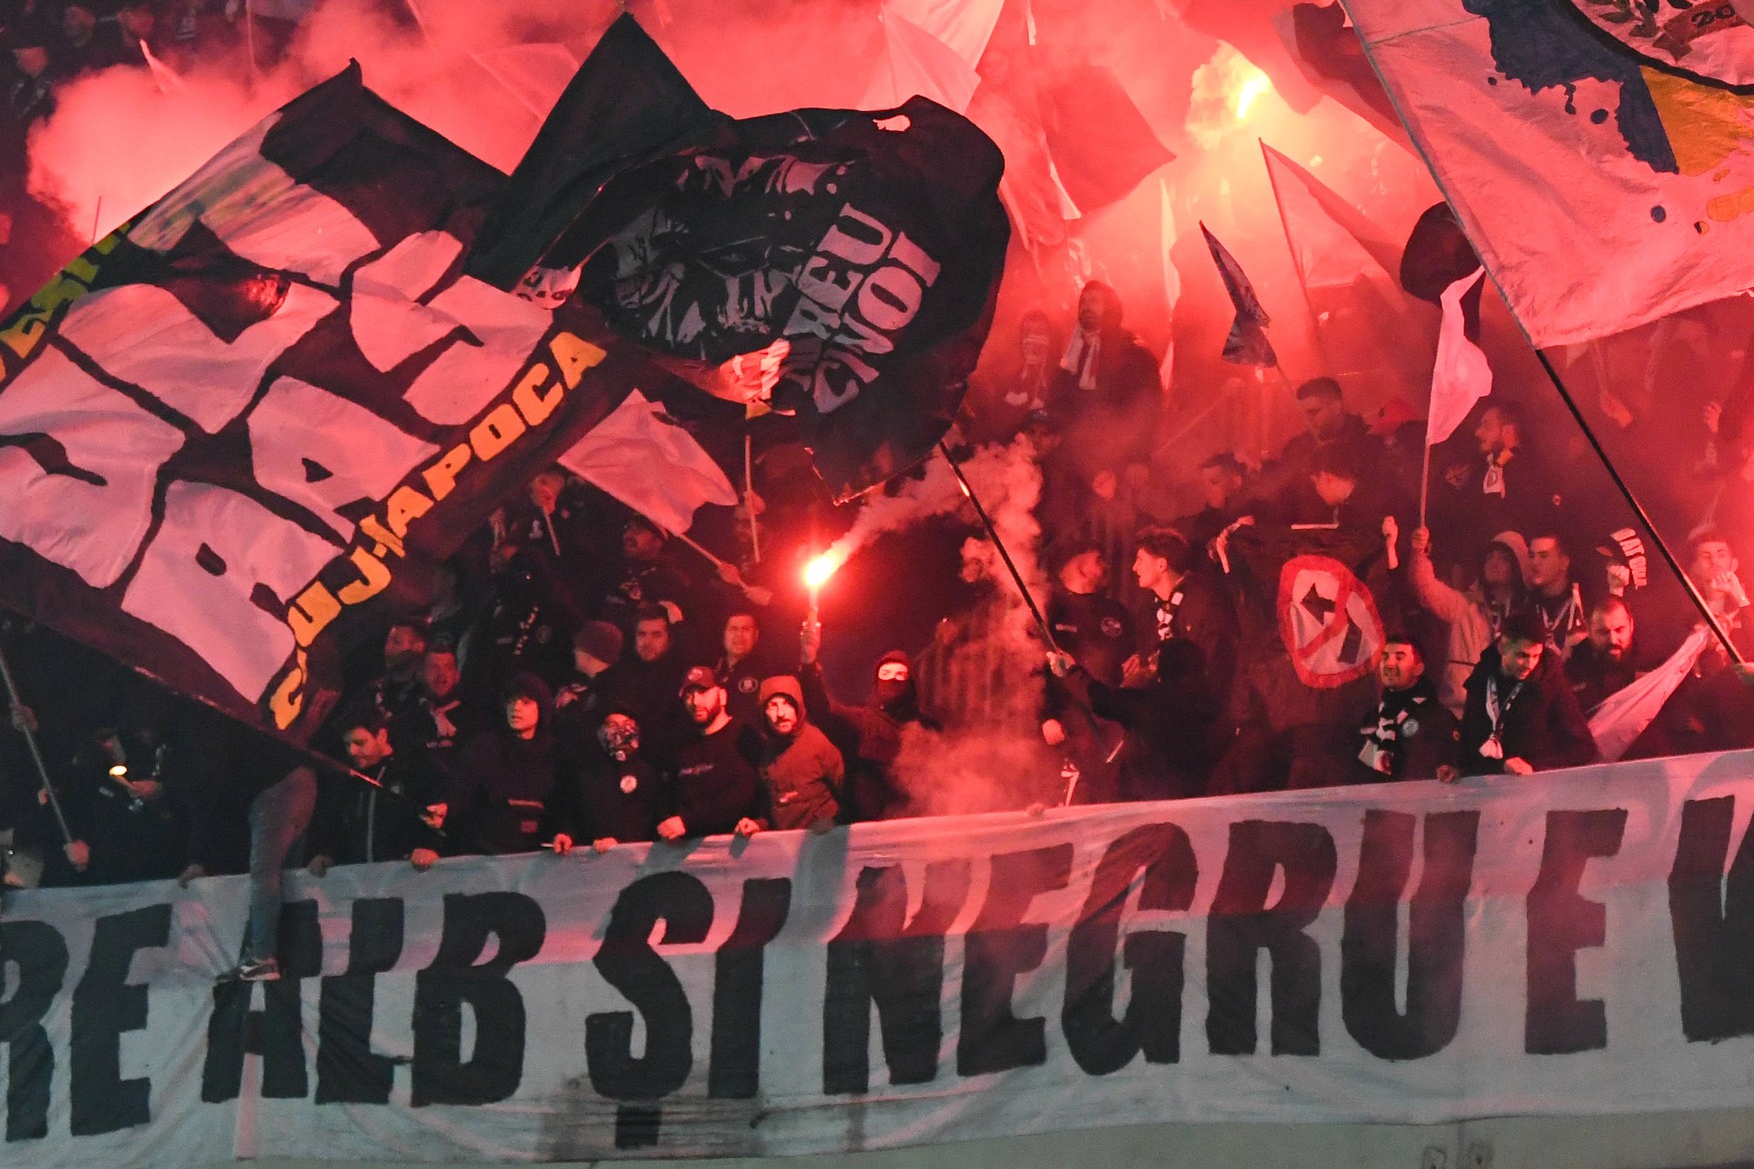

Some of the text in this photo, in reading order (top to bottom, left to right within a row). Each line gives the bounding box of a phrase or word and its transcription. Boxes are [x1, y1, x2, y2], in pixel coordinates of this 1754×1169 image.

[269, 331, 607, 730] CUJ-APOCA
[201, 892, 547, 1107] ALB
[585, 870, 792, 1149] ȘI
[823, 810, 1481, 1095] NEGRU
[1525, 809, 1628, 1054] E
